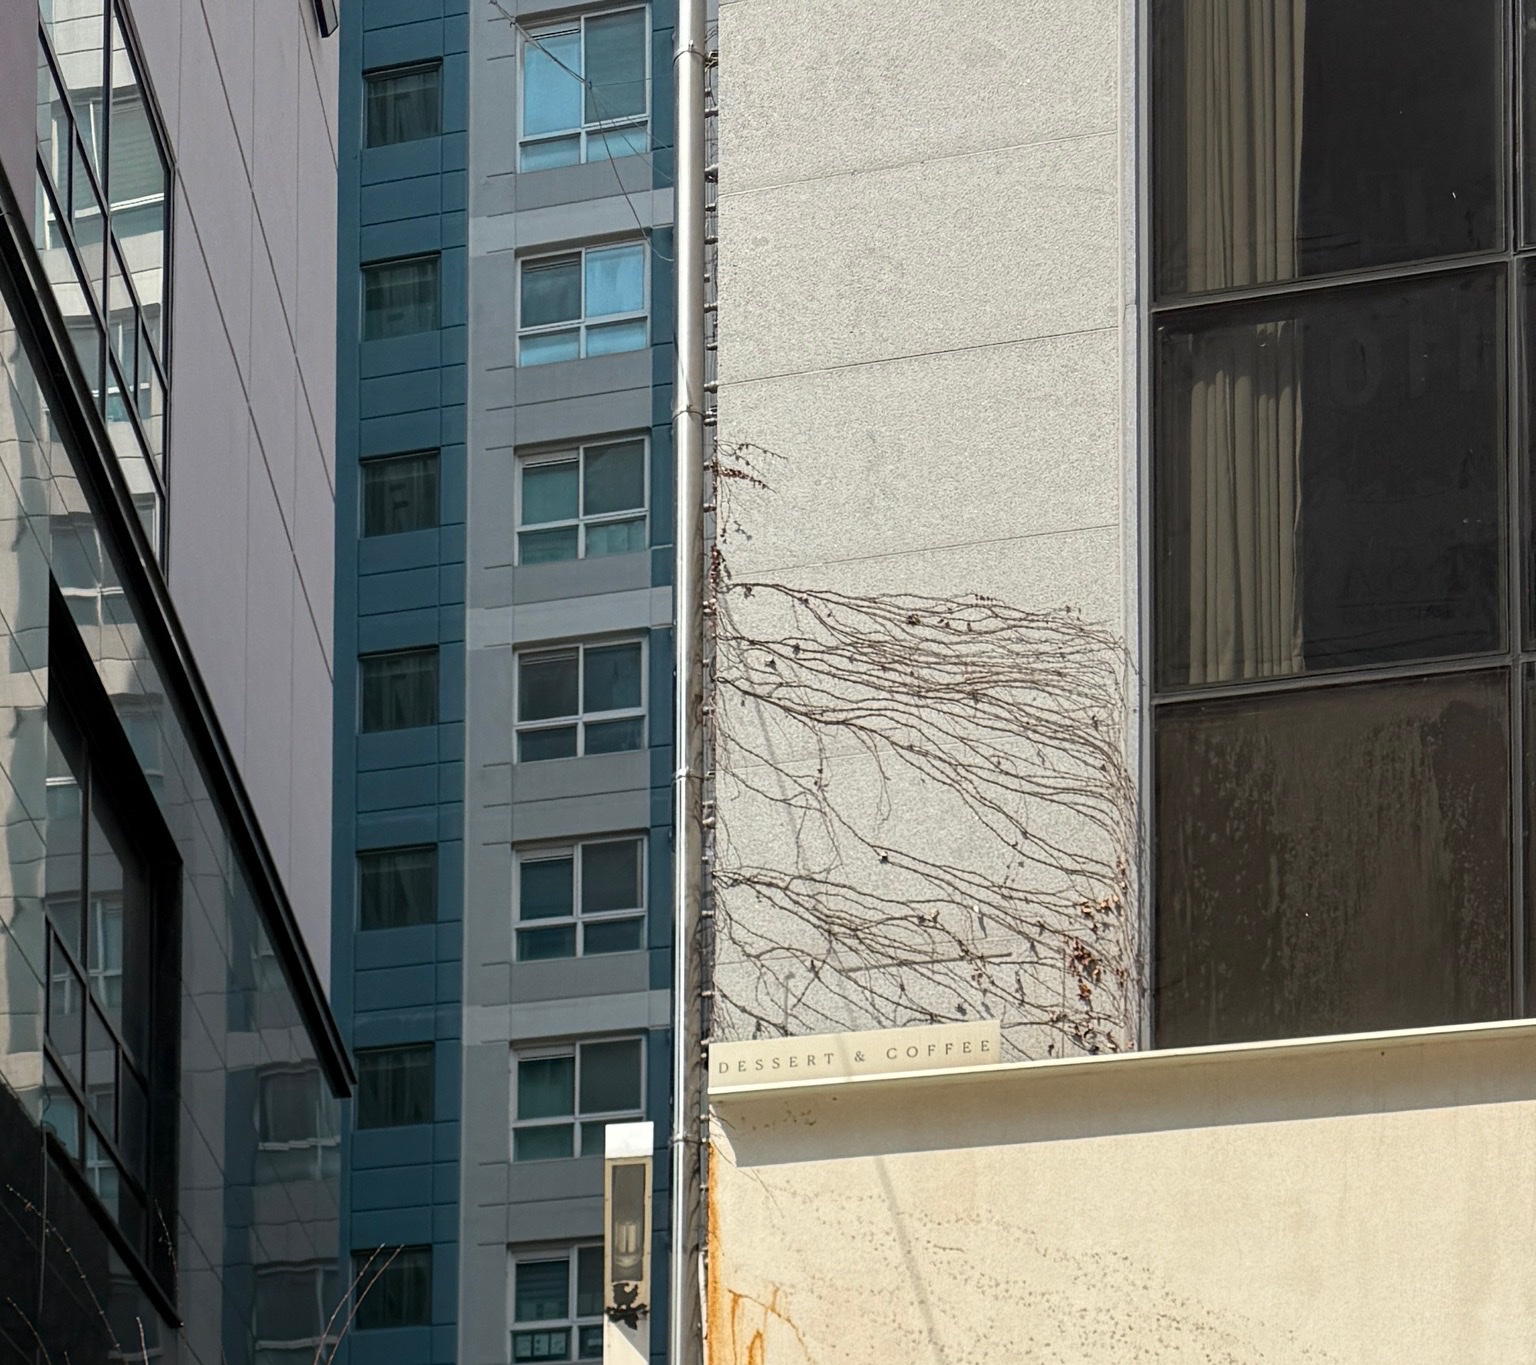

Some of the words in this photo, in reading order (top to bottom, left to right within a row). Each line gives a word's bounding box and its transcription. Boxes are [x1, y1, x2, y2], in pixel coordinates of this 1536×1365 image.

[718, 1052, 835, 1074] DESSERT
[853, 1050, 865, 1063] &
[886, 1040, 990, 1060] COFFEE
